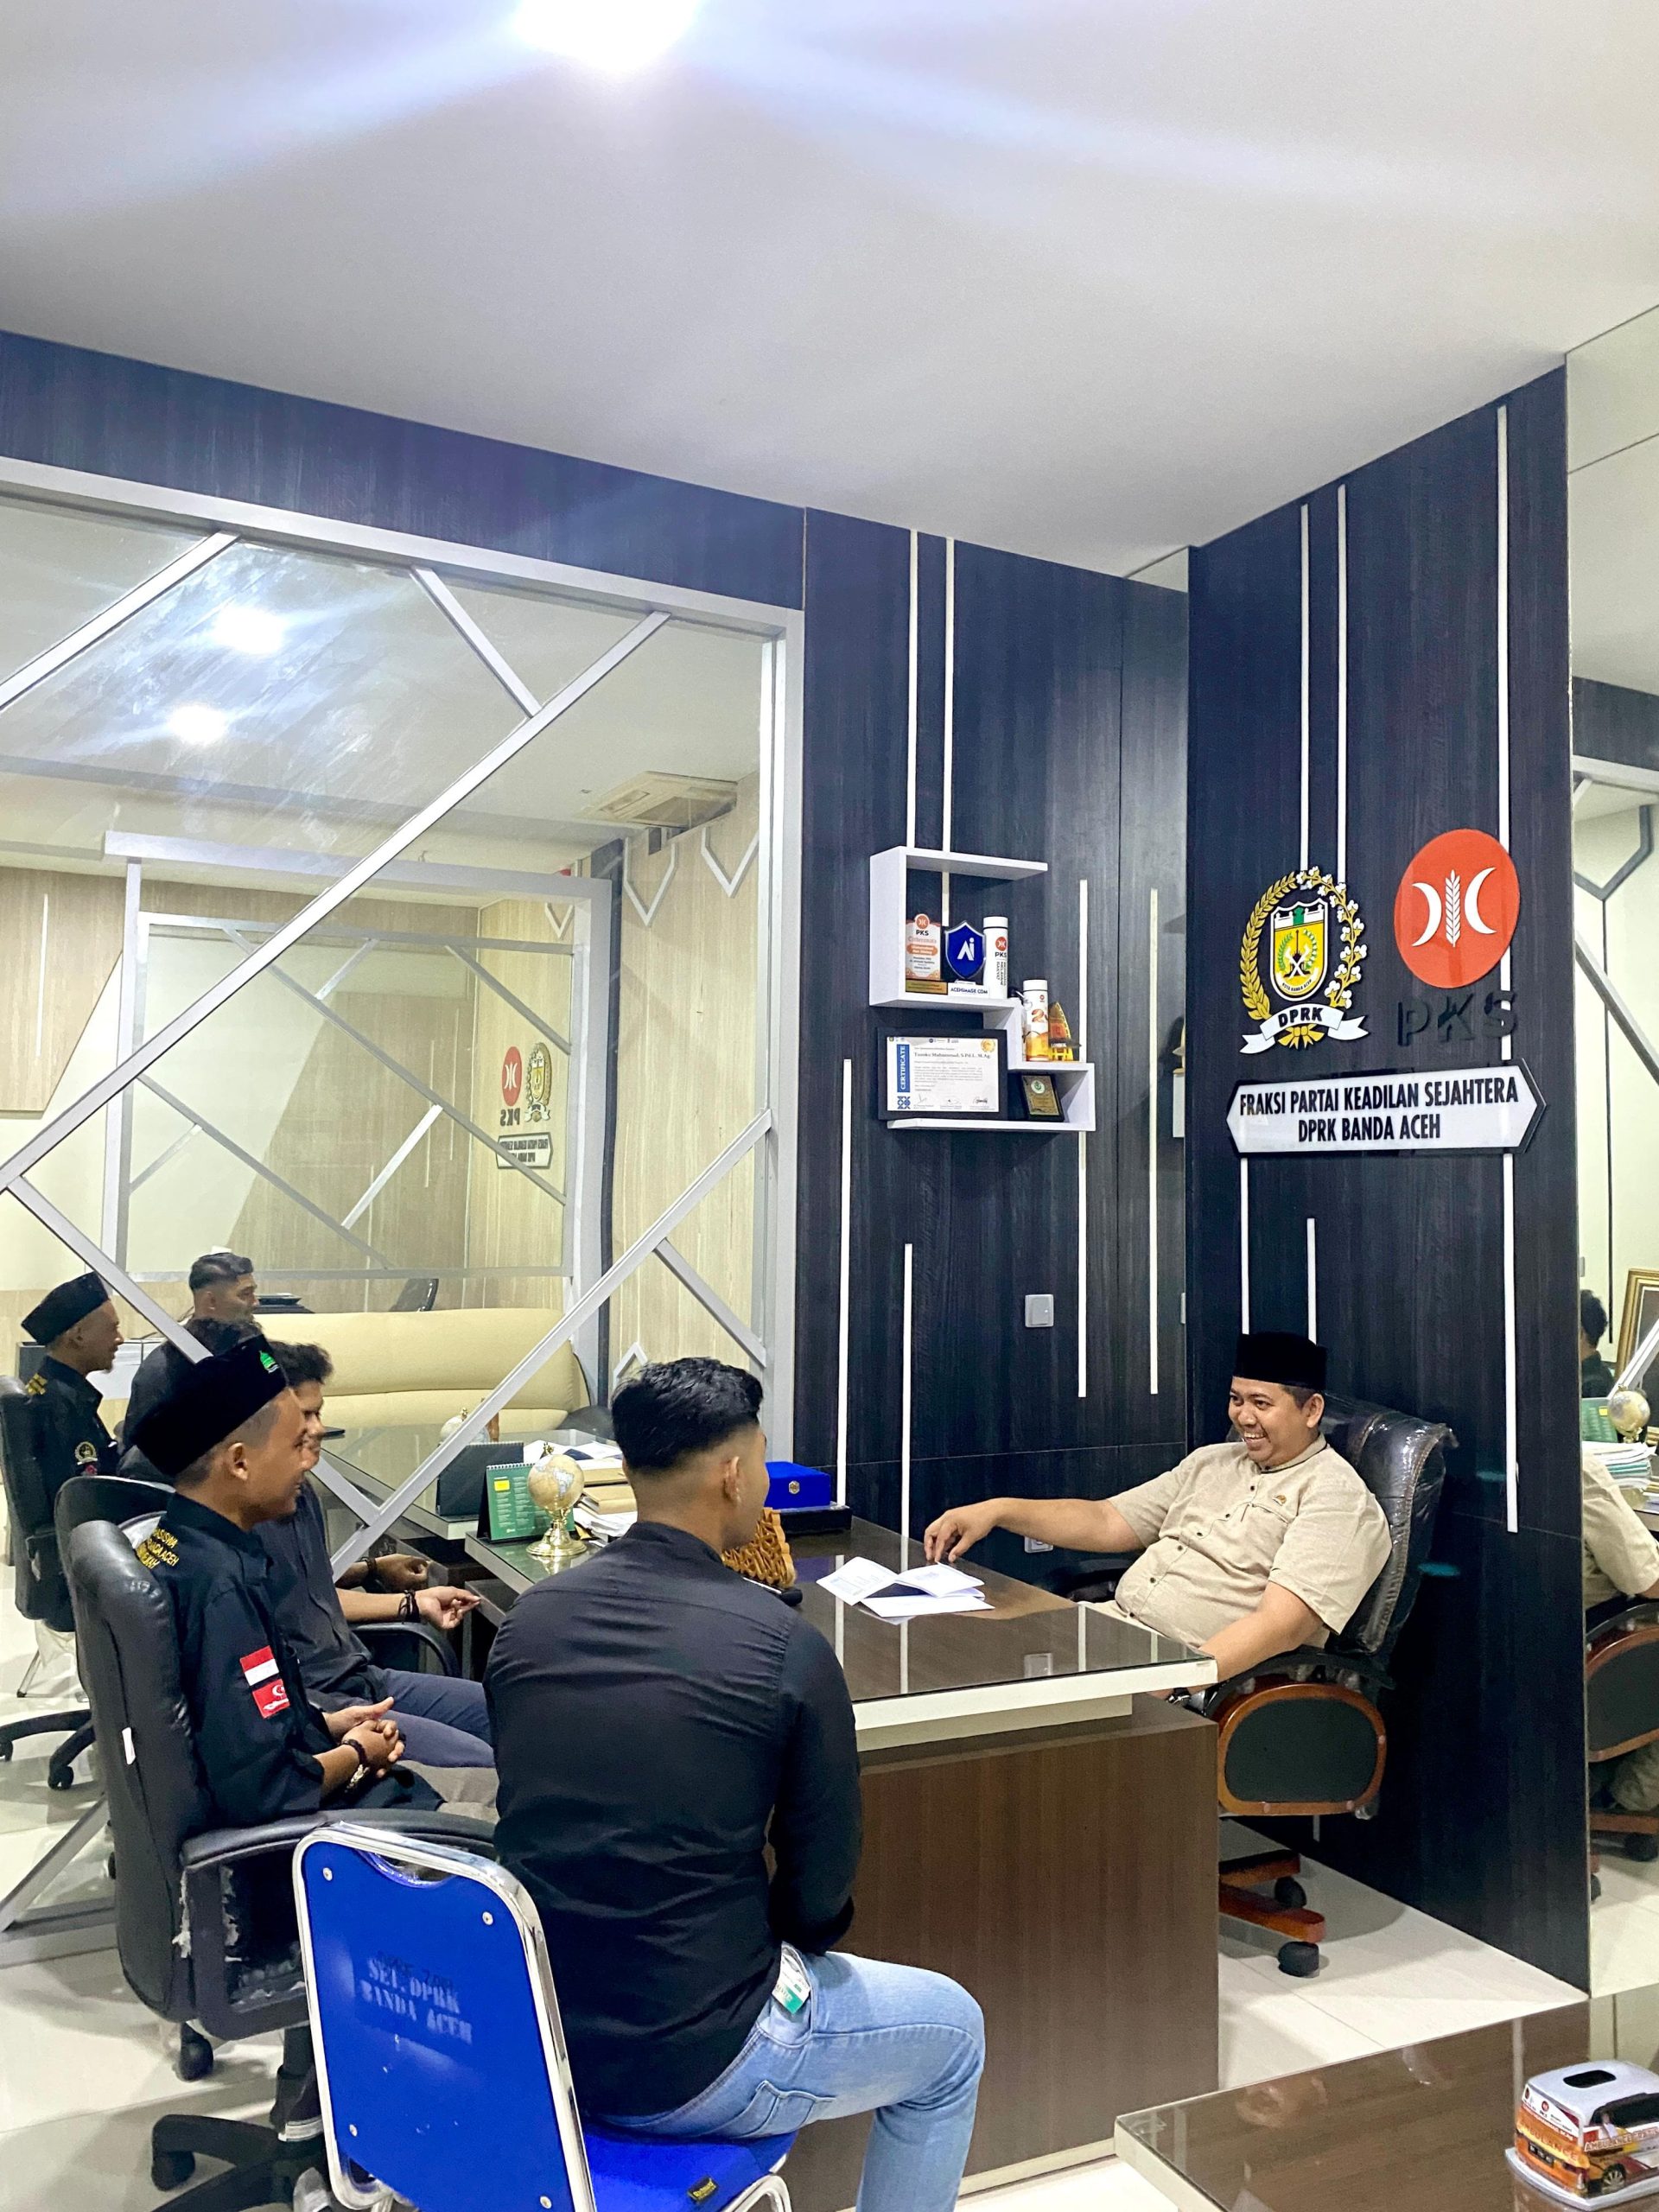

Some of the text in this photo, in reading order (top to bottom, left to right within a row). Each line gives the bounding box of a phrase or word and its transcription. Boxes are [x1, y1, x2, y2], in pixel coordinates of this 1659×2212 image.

[1278, 1007, 1324, 1028] DPRK
[1397, 990, 1517, 1046] PKS
[1240, 1077, 1519, 1116] FRAKSI PARTAI KEADILAN SEJAHTERA
[1298, 1114, 1441, 1142] DPRK BANDA ACEH
[159, 1550, 180, 1567] ACEH
